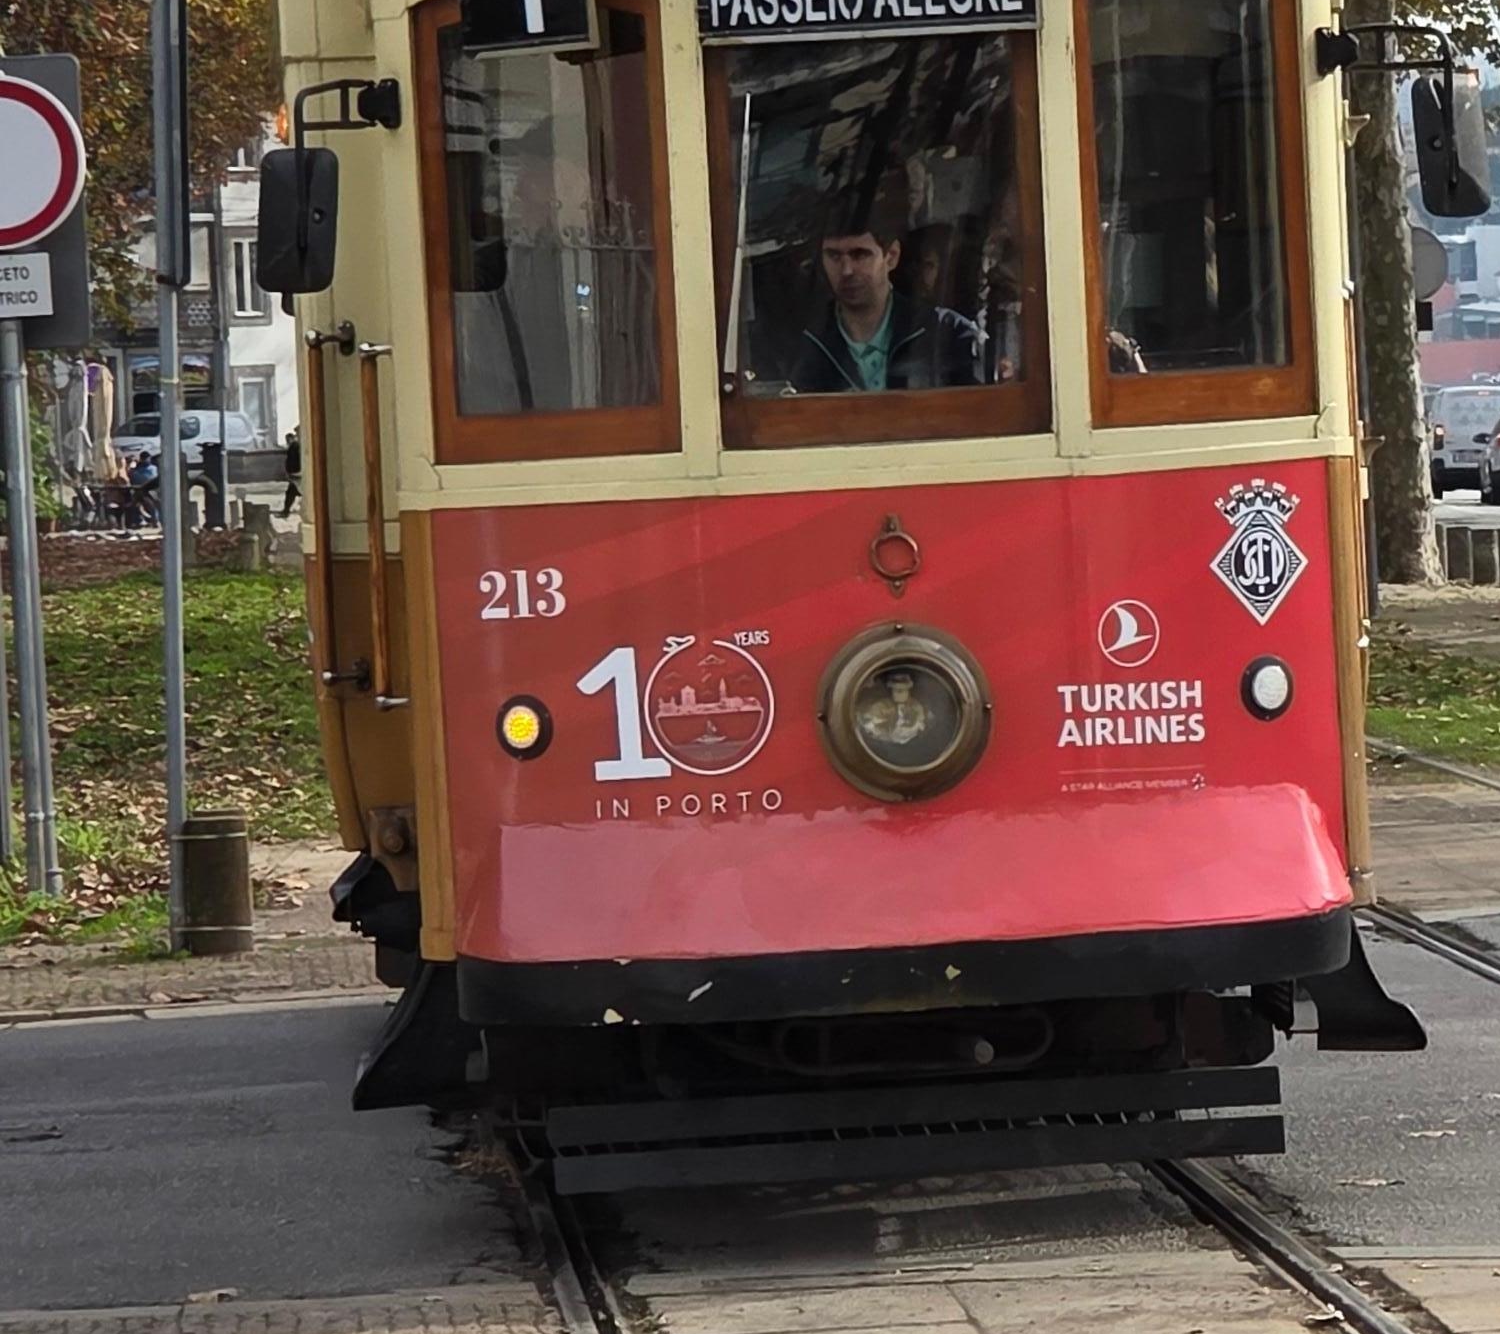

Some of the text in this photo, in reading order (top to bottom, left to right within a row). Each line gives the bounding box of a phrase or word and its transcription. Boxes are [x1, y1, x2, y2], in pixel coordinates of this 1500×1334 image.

[479, 567, 567, 620] 213
[733, 630, 770, 646] YEARS
[1057, 680, 1203, 714] TURKISH
[1057, 713, 1206, 748] AIRLINES
[596, 788, 783, 819] IN PORTO
